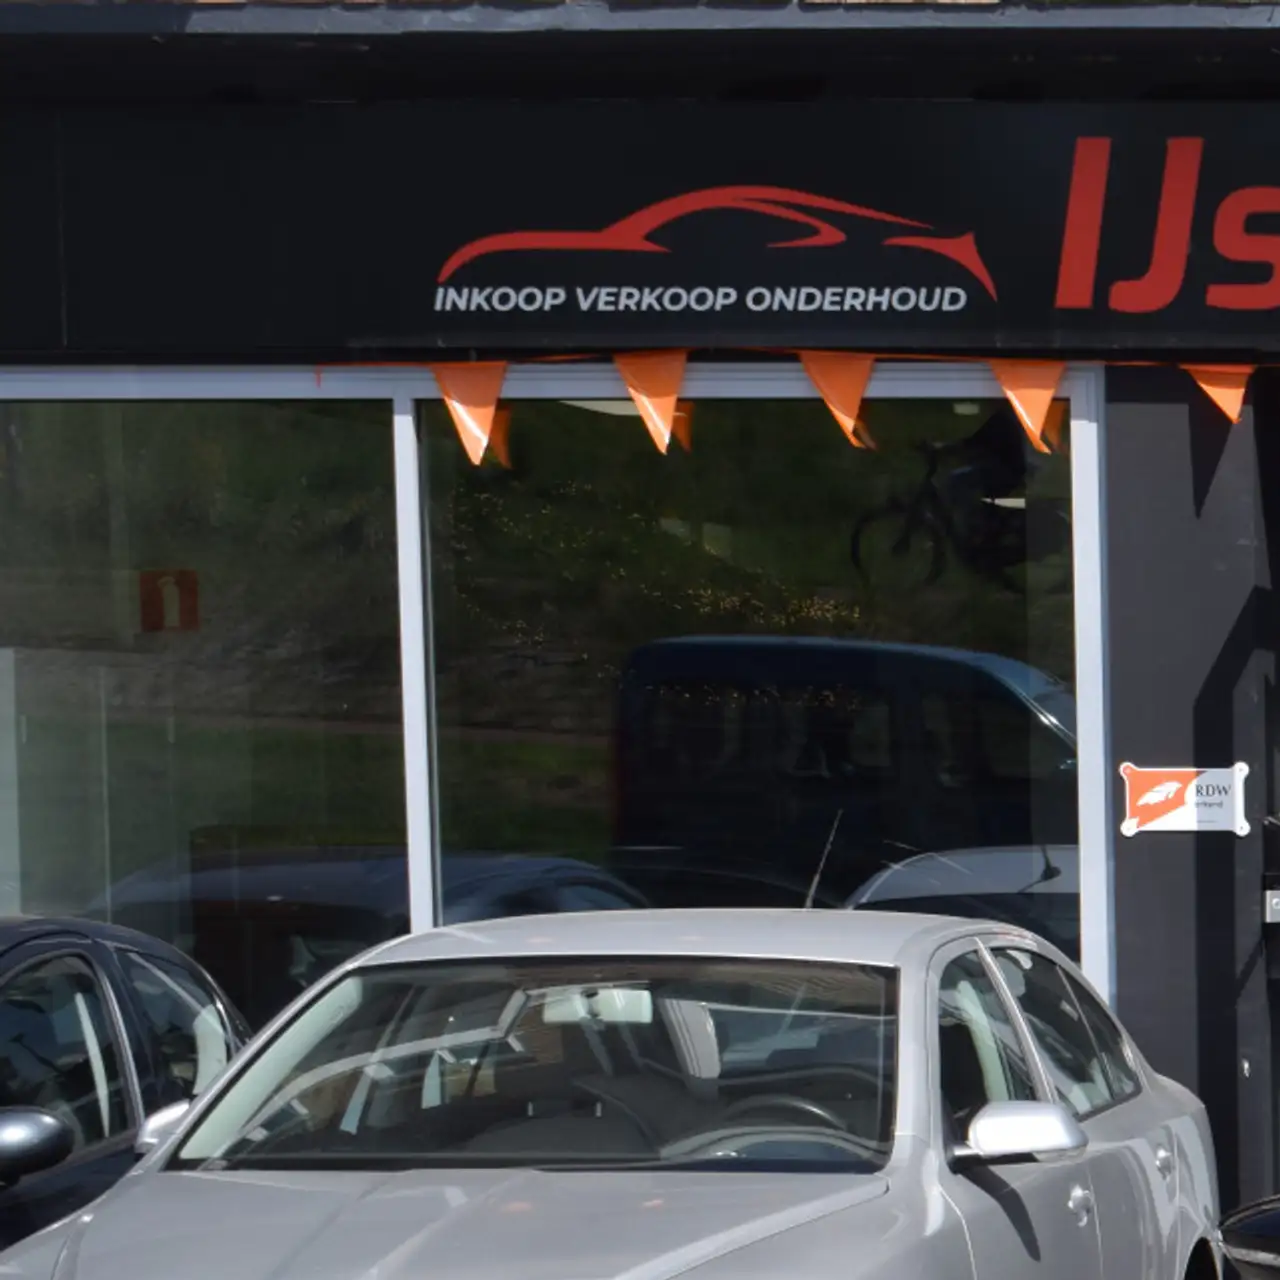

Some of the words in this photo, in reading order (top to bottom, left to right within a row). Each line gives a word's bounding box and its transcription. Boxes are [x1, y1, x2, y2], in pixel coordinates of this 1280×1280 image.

[433, 286, 566, 312] INKOOP
[575, 286, 738, 312] VERKOOP
[744, 286, 968, 312] ONDERHOUD
[1195, 784, 1231, 797] RDW
